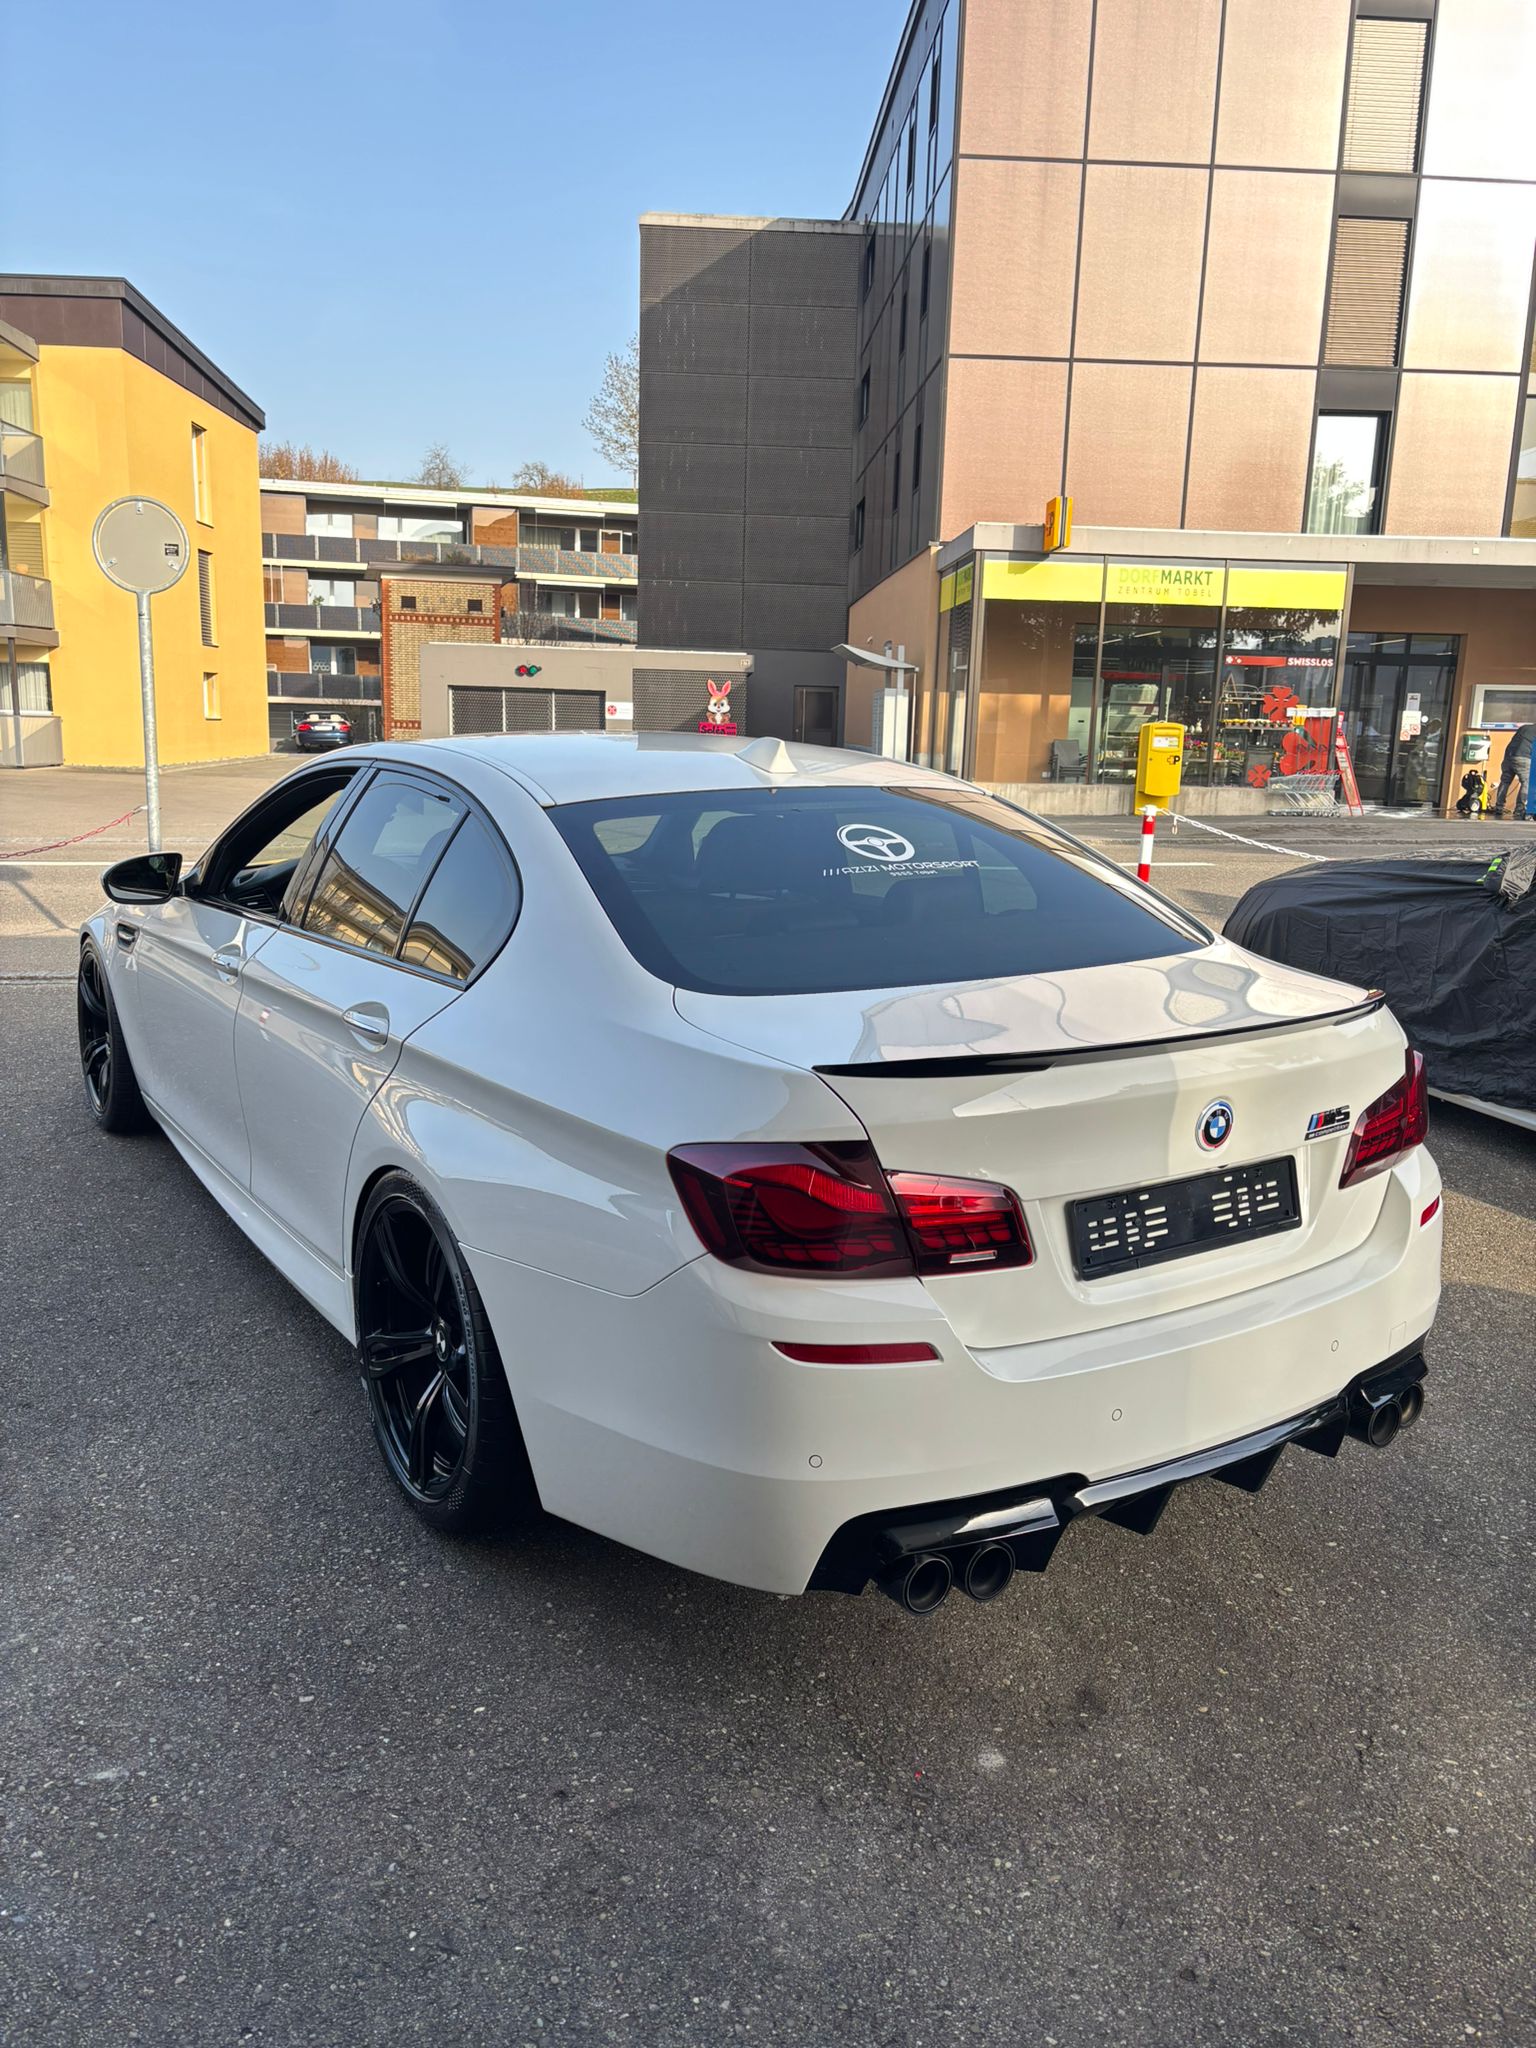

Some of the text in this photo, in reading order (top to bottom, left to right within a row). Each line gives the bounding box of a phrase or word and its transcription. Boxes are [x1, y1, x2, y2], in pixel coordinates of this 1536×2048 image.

[1117, 586, 1212, 598] ZENTRUM TOBEL
[1287, 656, 1334, 667] SWISSLOS
[880, 860, 980, 872] MOTORSPORT
